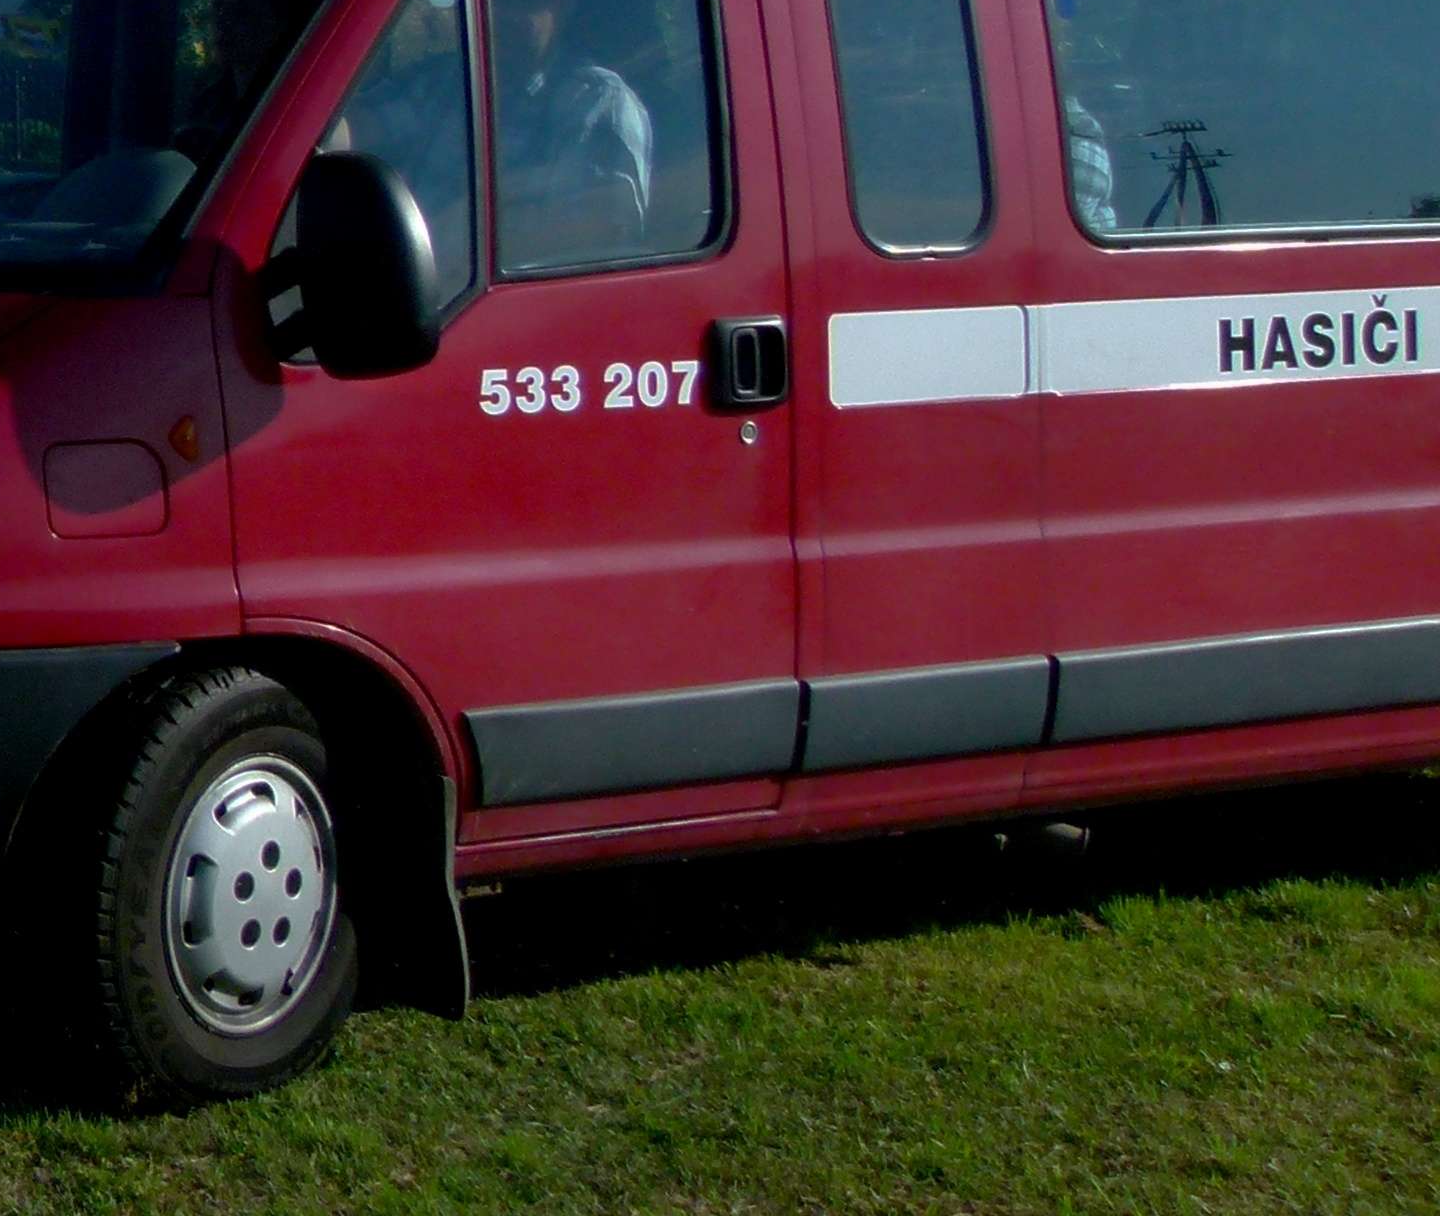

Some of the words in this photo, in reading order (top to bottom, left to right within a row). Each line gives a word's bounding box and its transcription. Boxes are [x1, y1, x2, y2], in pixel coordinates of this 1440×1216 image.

[1218, 294, 1419, 373] HASIČI
[480, 365, 581, 415] 533
[603, 361, 699, 408] 207
